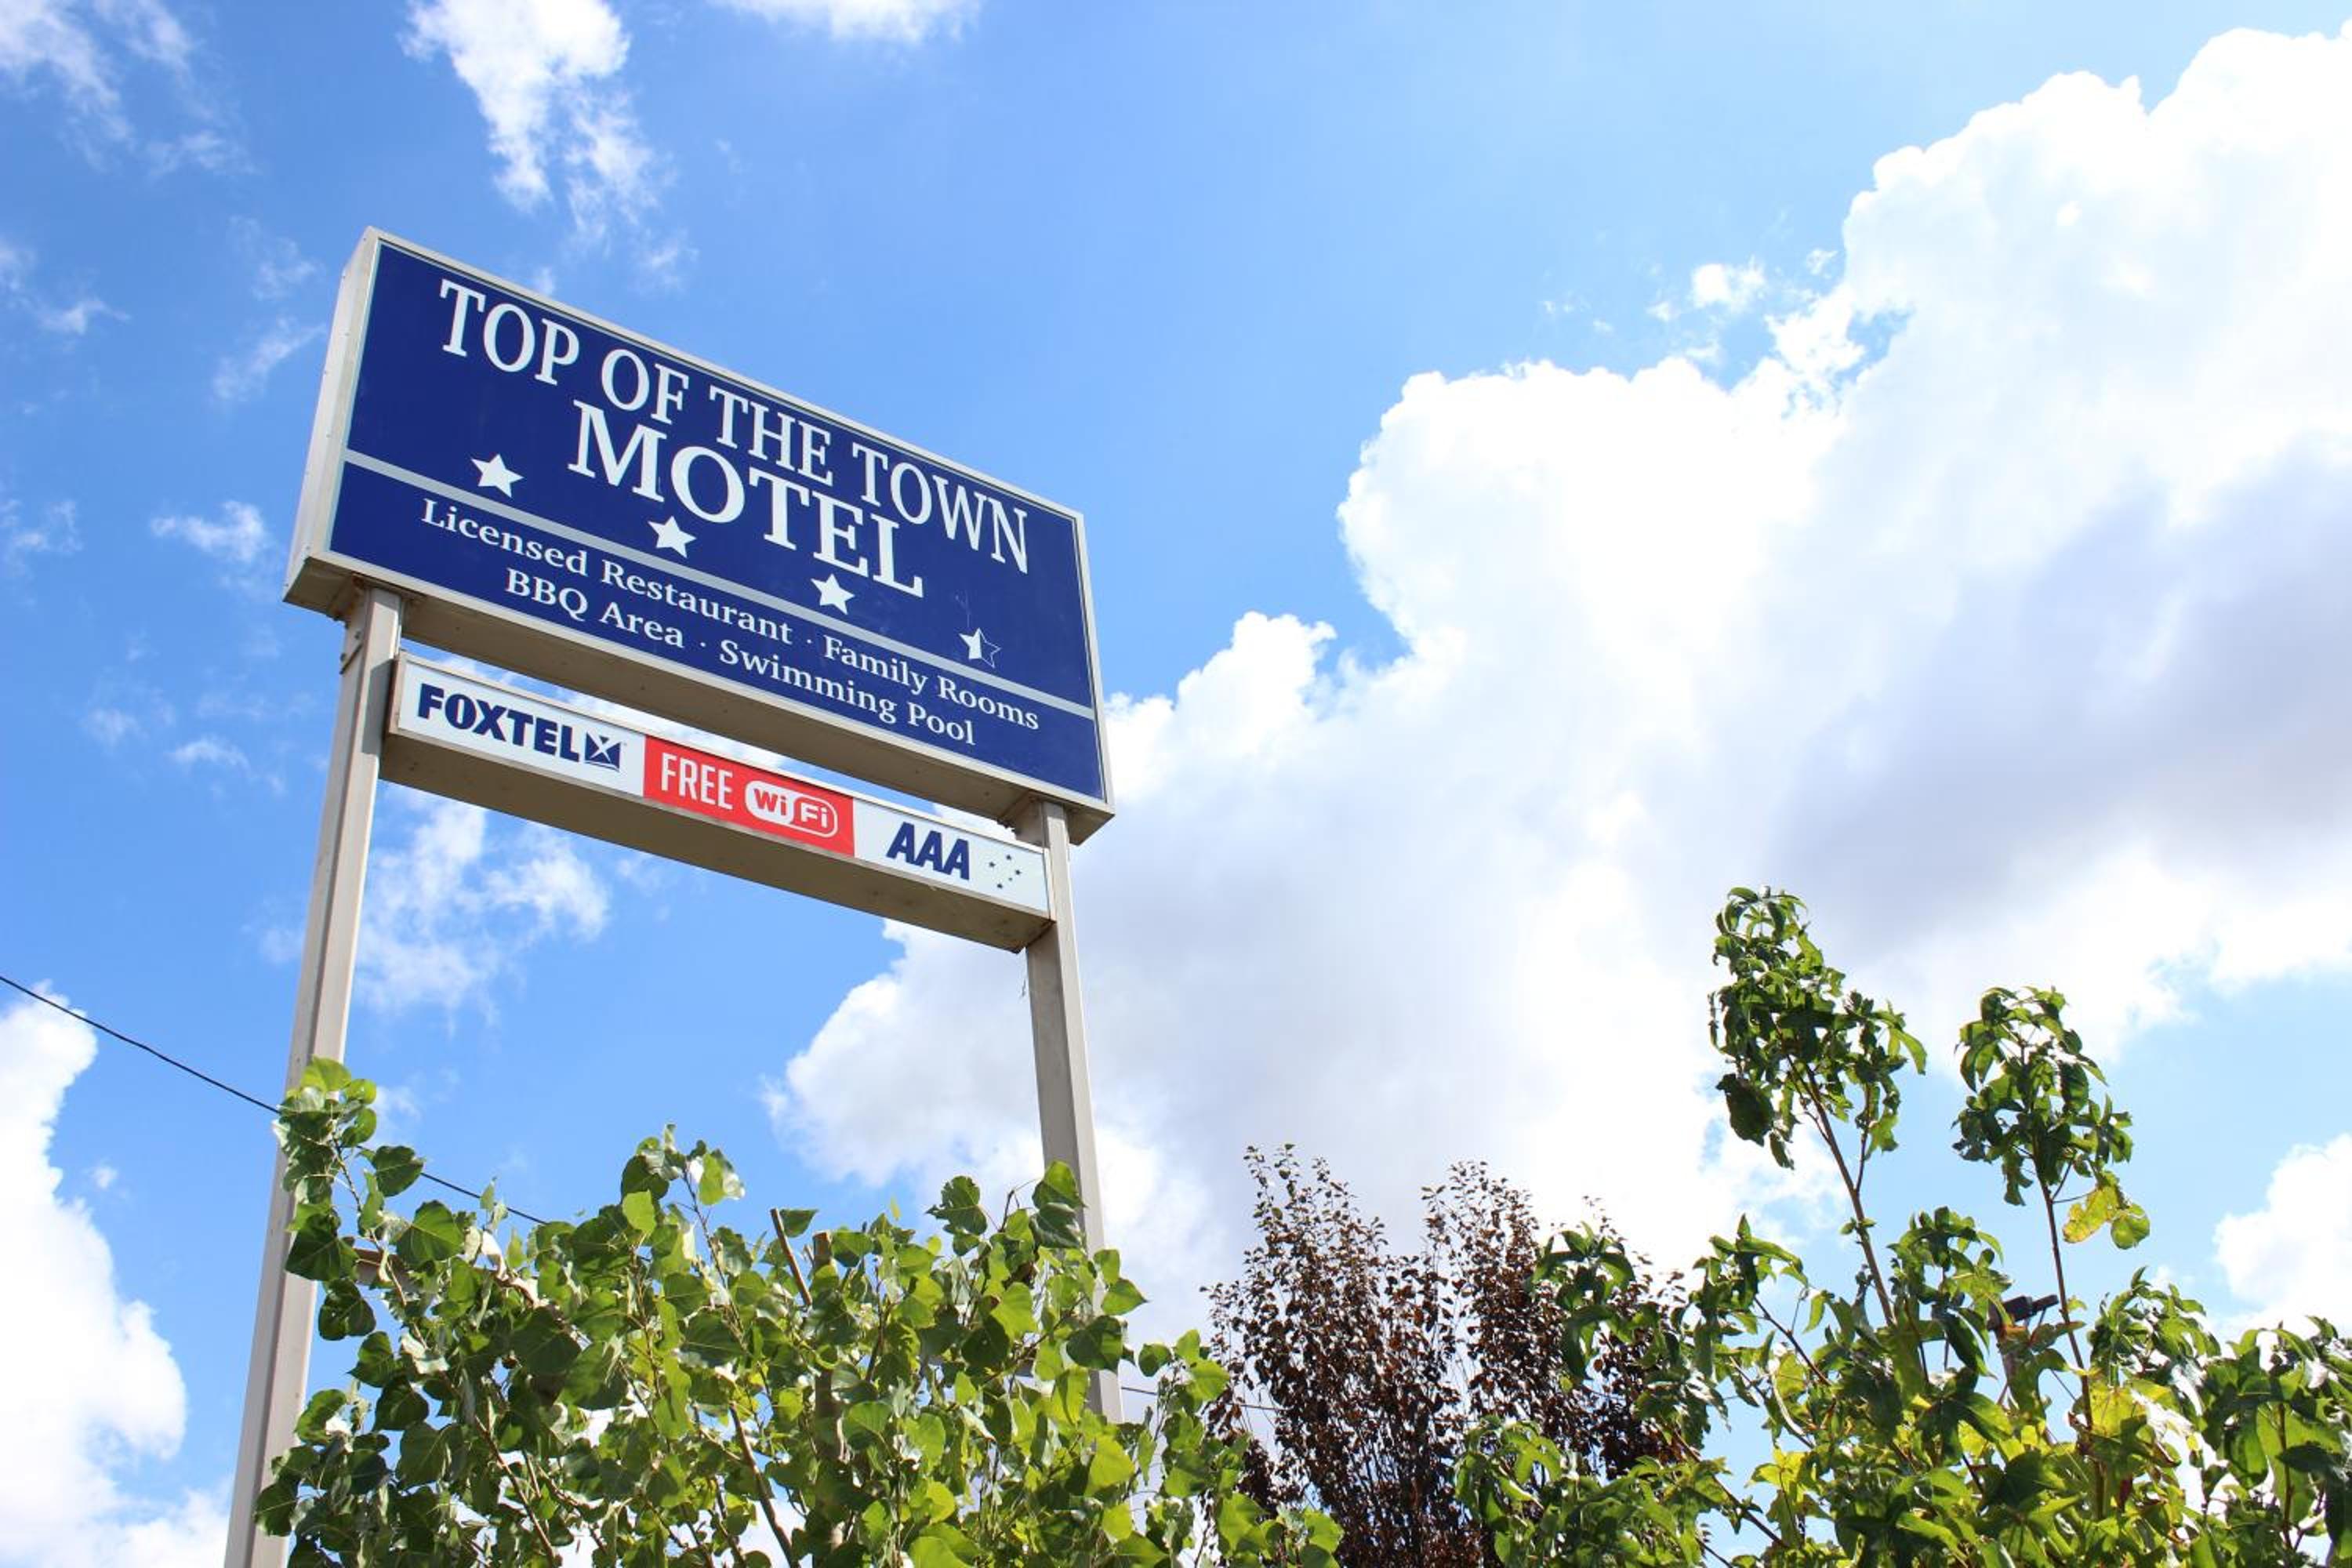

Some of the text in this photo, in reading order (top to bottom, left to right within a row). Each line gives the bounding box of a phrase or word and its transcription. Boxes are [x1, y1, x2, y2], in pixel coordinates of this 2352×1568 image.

[440, 278, 1028, 574] TOP OF THE TOWN
[568, 399, 924, 598] MOTEL
[420, 498, 1040, 730] Licensed Restaurant Family Rooms
[506, 567, 976, 745] BBQ Area Swimming Pool
[417, 683, 579, 762] FOXTEL
[661, 752, 733, 810] FREE
[886, 822, 970, 880] AAA
